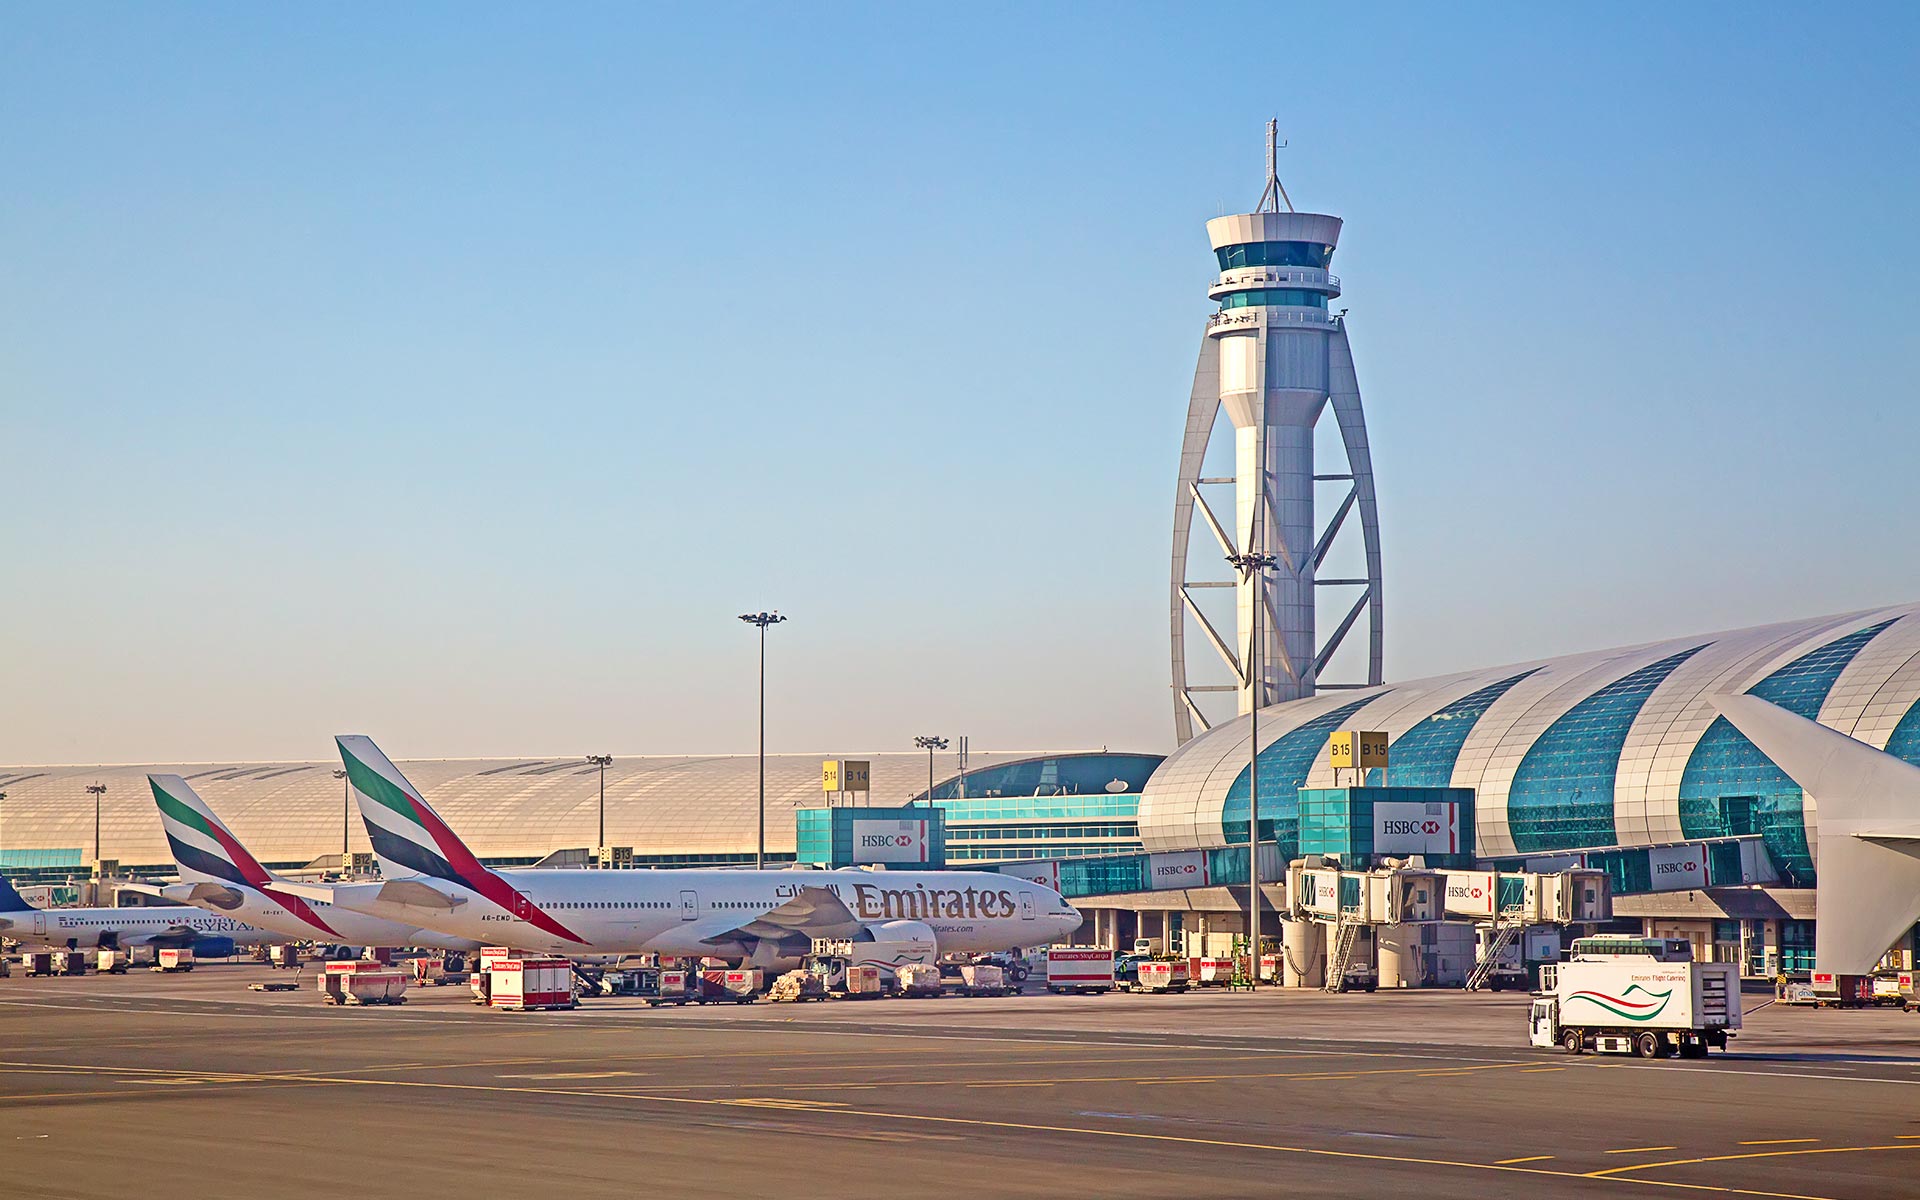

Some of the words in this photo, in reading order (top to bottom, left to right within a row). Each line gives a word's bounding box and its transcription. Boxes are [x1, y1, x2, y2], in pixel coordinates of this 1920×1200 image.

[1332, 744, 1338, 756] B
[1340, 744, 1350, 756] 15
[1362, 744, 1371, 755] B
[1374, 744, 1386, 756] 15
[824, 771, 829, 781] B
[830, 771, 837, 781] 14
[847, 770, 854, 781] B
[857, 770, 867, 781] 14
[1383, 820, 1420, 835] HSBC
[861, 835, 894, 847] HSBC
[1157, 865, 1183, 876] HSBC
[1656, 862, 1683, 874] HSBC
[1448, 886, 1470, 898] HSBC
[852, 883, 1016, 919] Emirates
[929, 923, 974, 933] irates.com
[1080, 952, 1109, 960] SkyCargo
[1652, 974, 1666, 983] Flight
